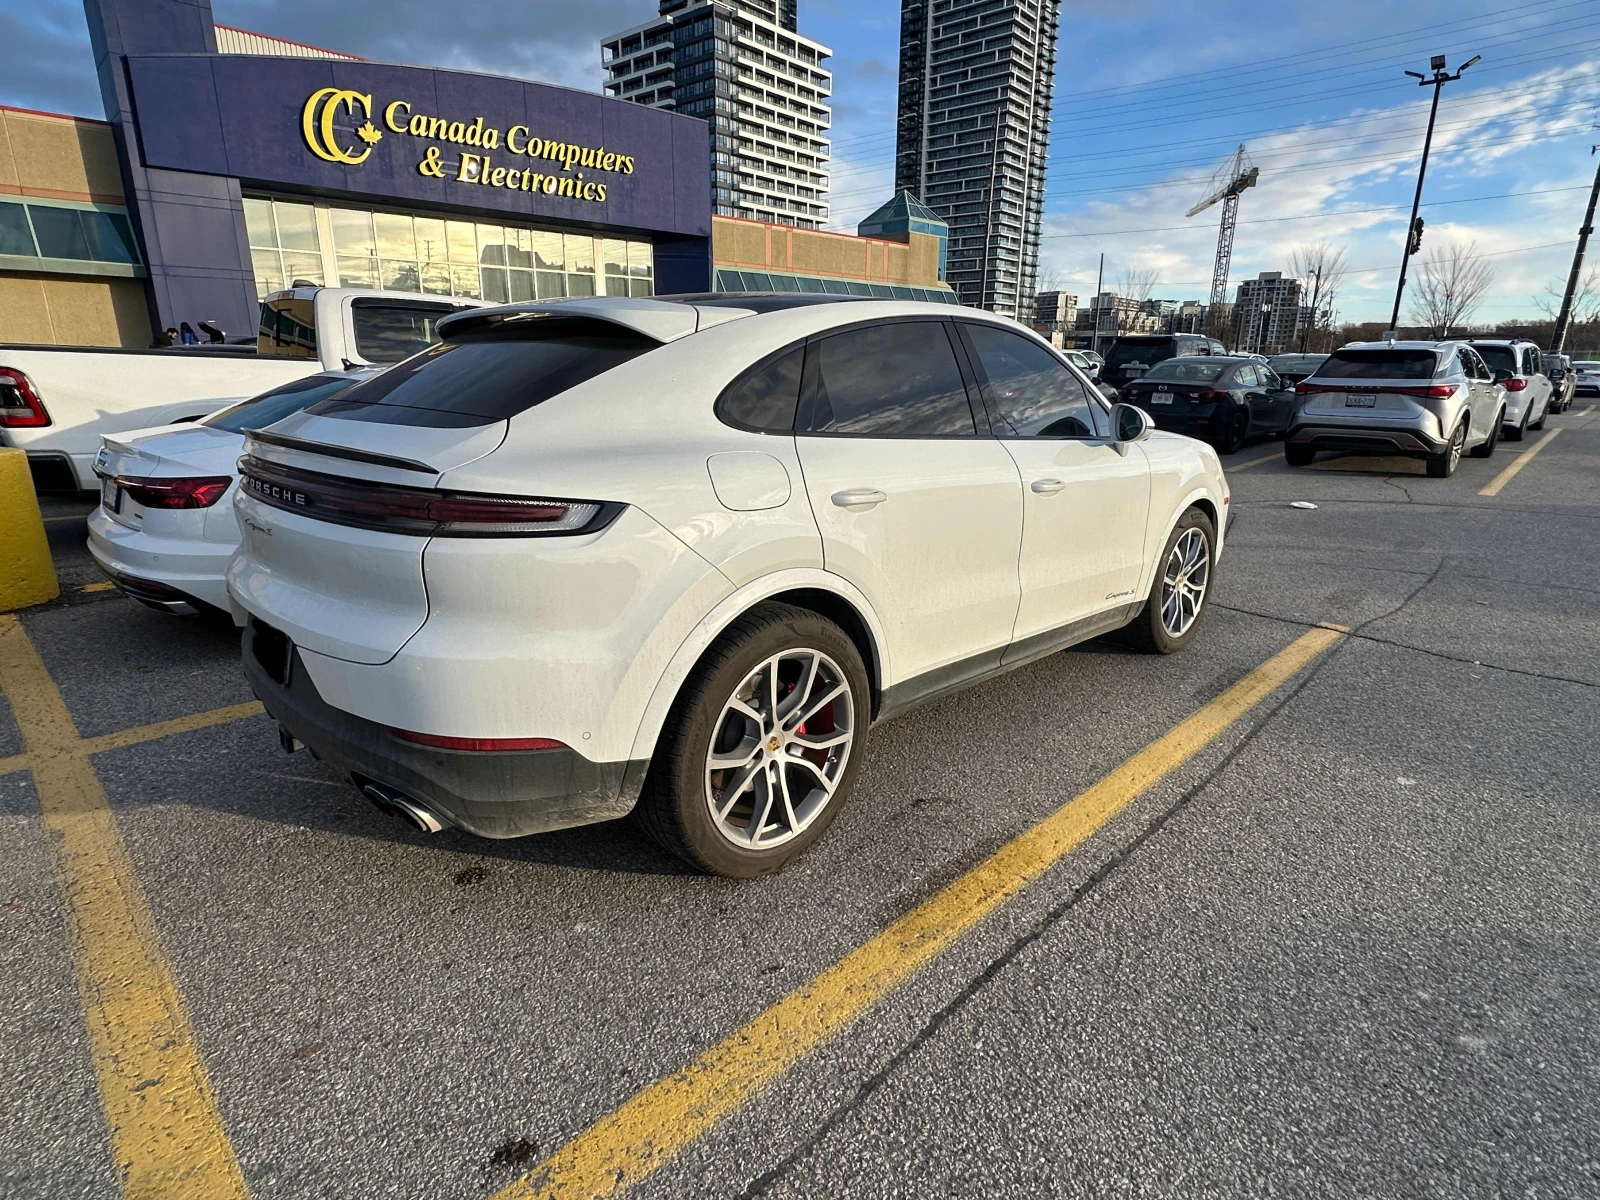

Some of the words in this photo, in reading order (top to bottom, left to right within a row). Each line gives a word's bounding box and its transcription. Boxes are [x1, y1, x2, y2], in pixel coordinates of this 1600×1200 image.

[385, 100, 499, 149] Canada
[507, 125, 635, 175] Computers
[419, 146, 446, 178] &
[456, 152, 608, 202] Electronics
[243, 475, 305, 505] PORSCHE
